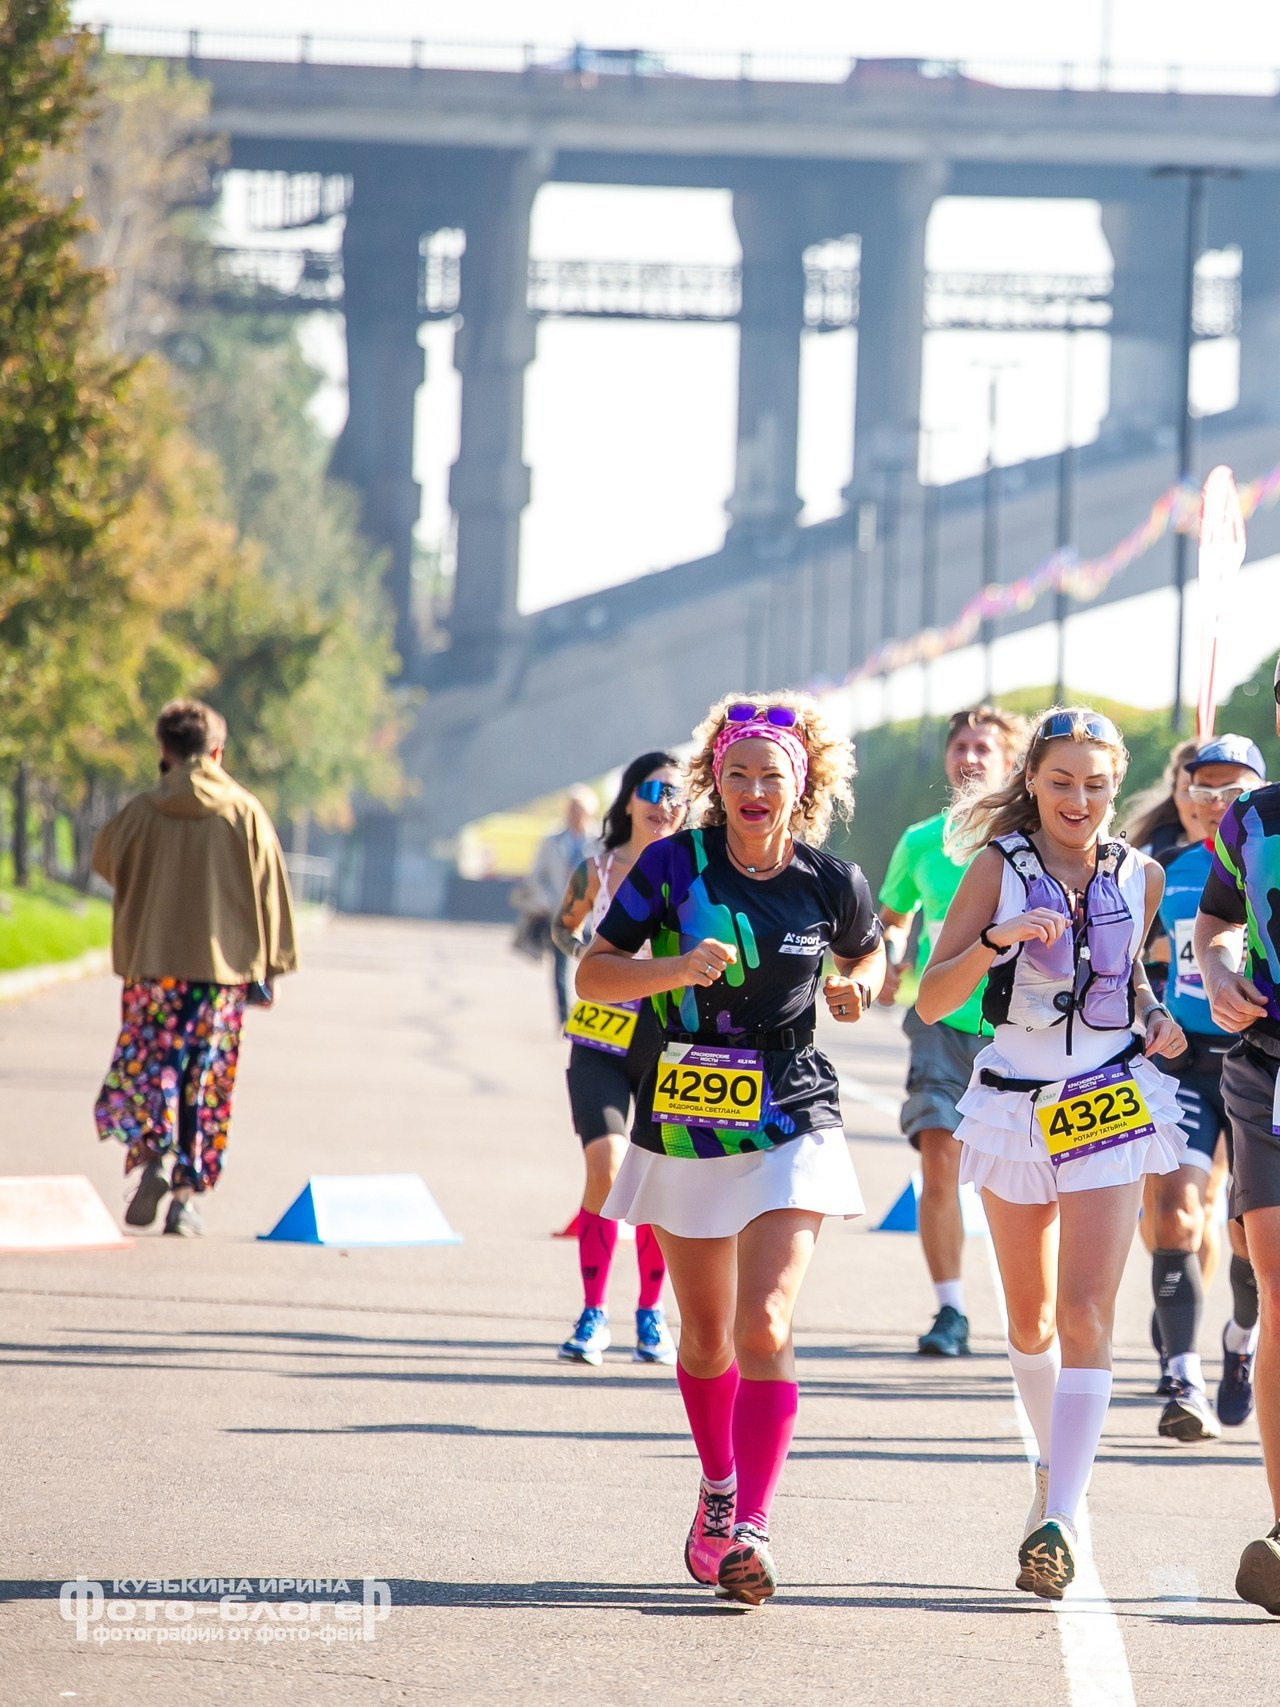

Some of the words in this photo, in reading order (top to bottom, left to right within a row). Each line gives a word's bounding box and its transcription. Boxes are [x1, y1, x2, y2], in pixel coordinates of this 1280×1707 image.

[574, 1005, 631, 1035] 4277
[658, 1069, 757, 1107] 4290
[668, 1103, 703, 1112] ФЕДОРОВА
[705, 1106, 740, 1114] СВЕТЛАНА
[1049, 1087, 1140, 1136] 4323
[1073, 1131, 1098, 1142] РОТАРУ
[1099, 1121, 1127, 1135] ТАТЬЯНА
